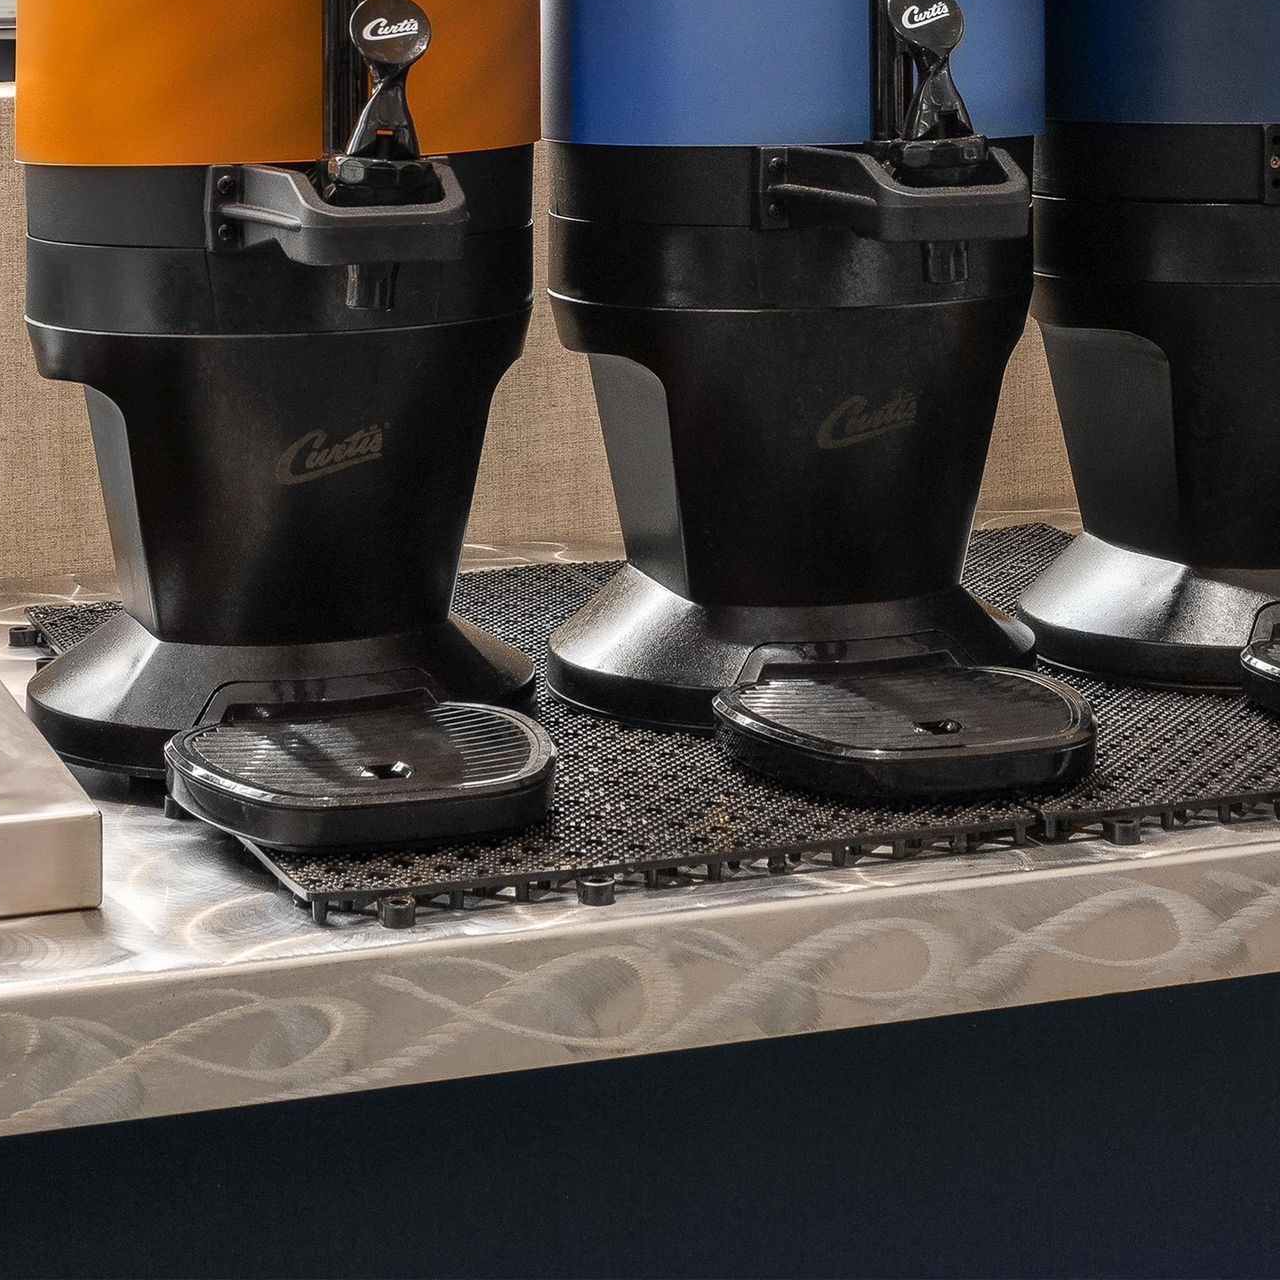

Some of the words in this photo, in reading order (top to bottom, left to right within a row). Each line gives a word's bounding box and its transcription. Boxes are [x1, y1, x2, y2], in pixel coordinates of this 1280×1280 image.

[362, 17, 419, 41] Curtis
[901, 1, 951, 29] Curtis
[275, 423, 383, 485] Curtis
